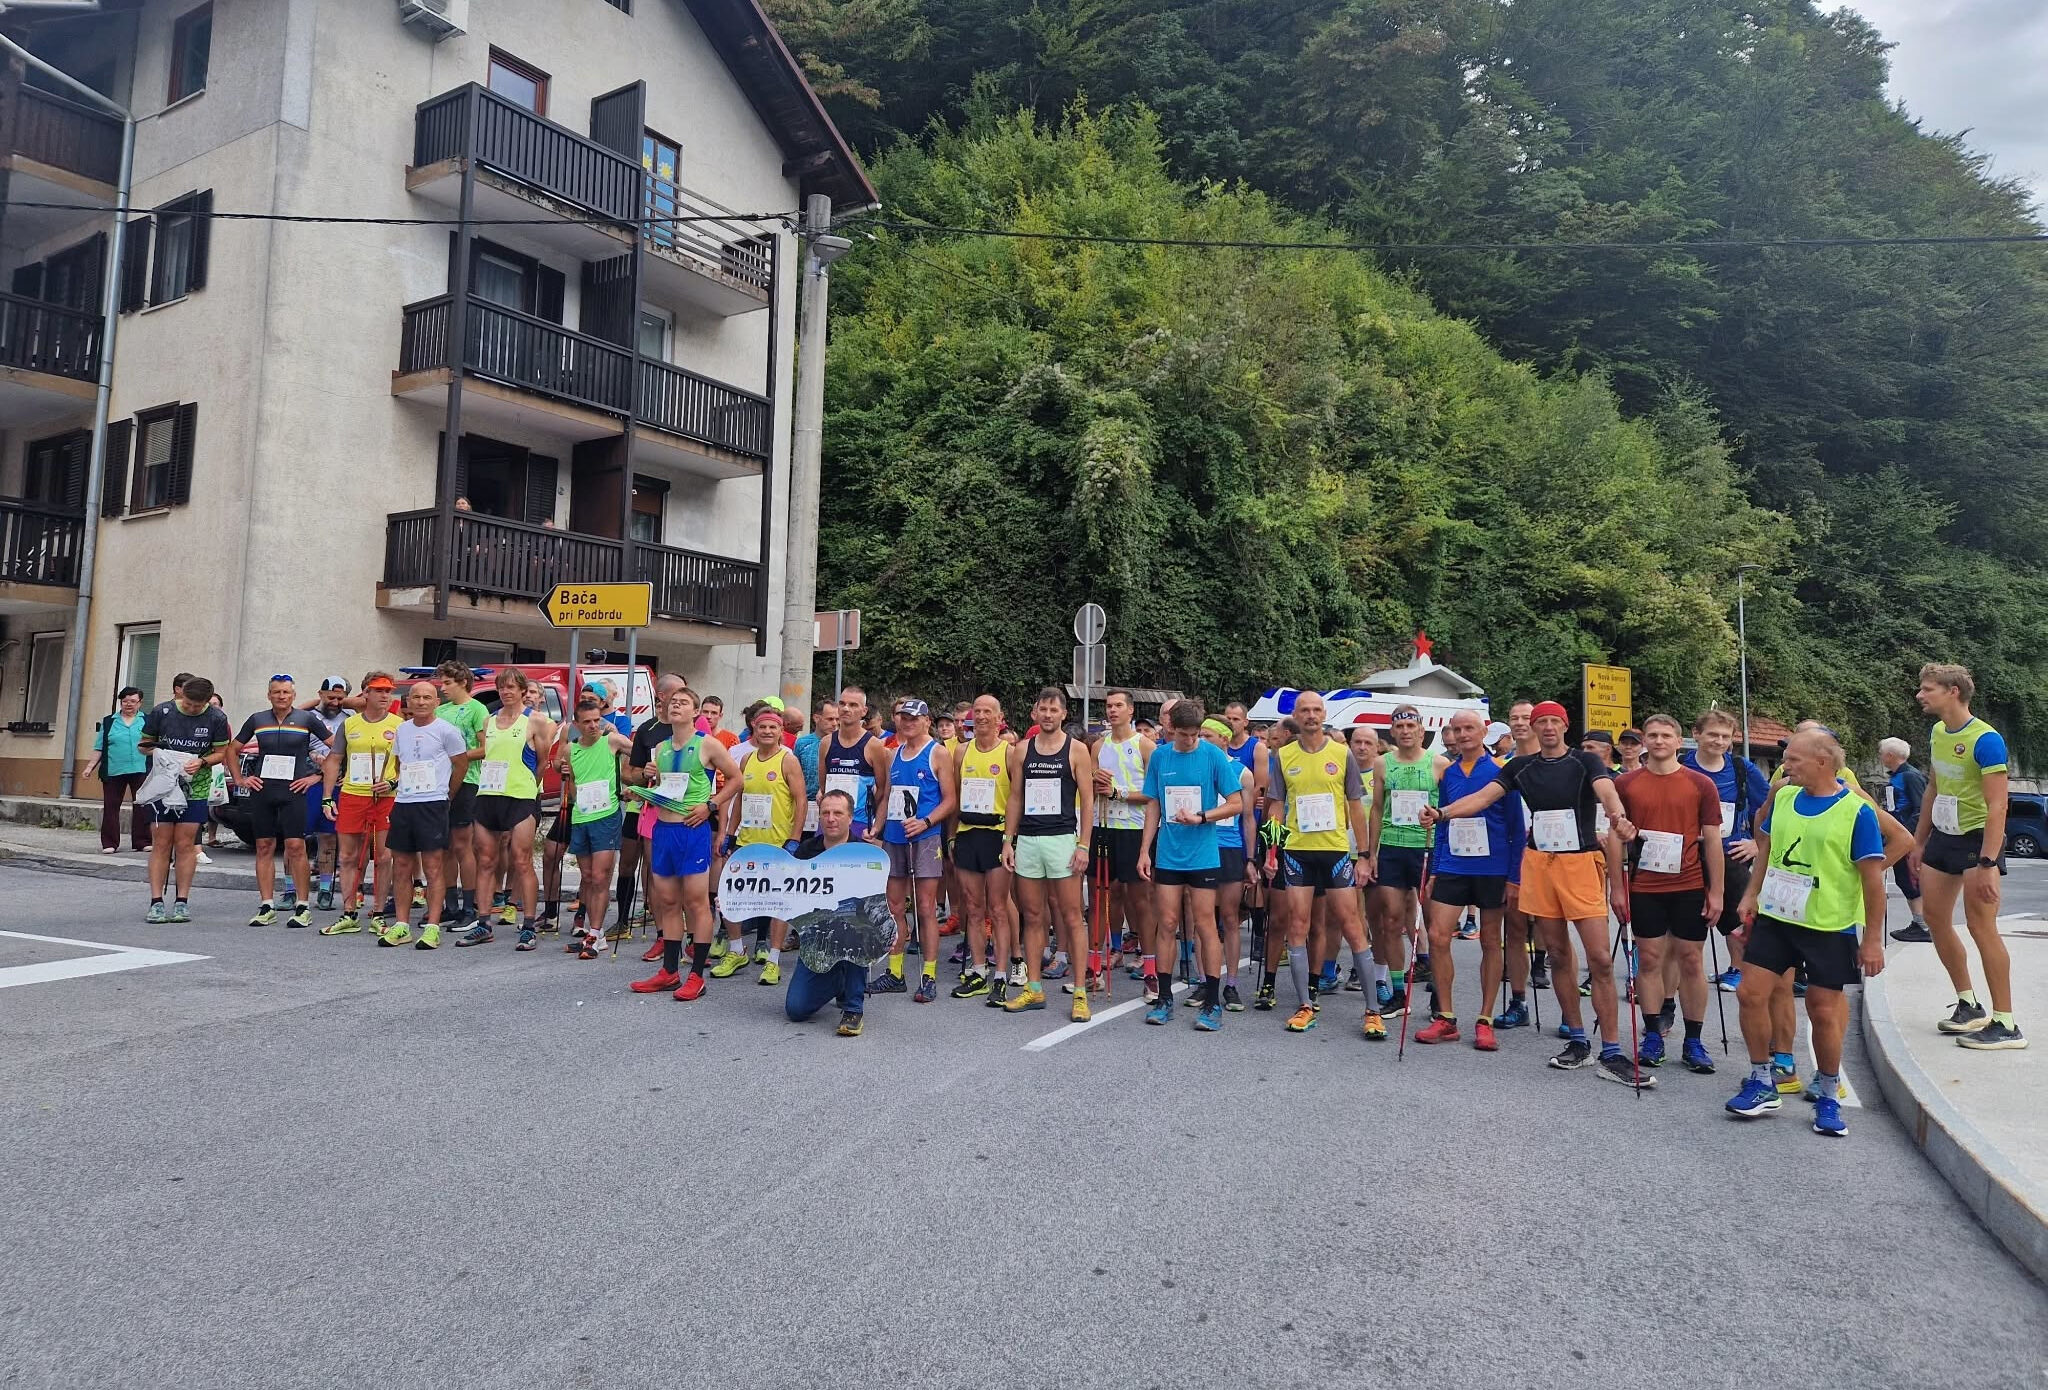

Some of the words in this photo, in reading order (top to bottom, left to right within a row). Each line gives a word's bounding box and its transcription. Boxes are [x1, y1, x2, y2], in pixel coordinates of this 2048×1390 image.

[560, 590, 597, 605] Bača
[559, 609, 573, 622] pri
[577, 609, 622, 620] Podbrdu
[1038, 762, 1063, 770] Olimpik
